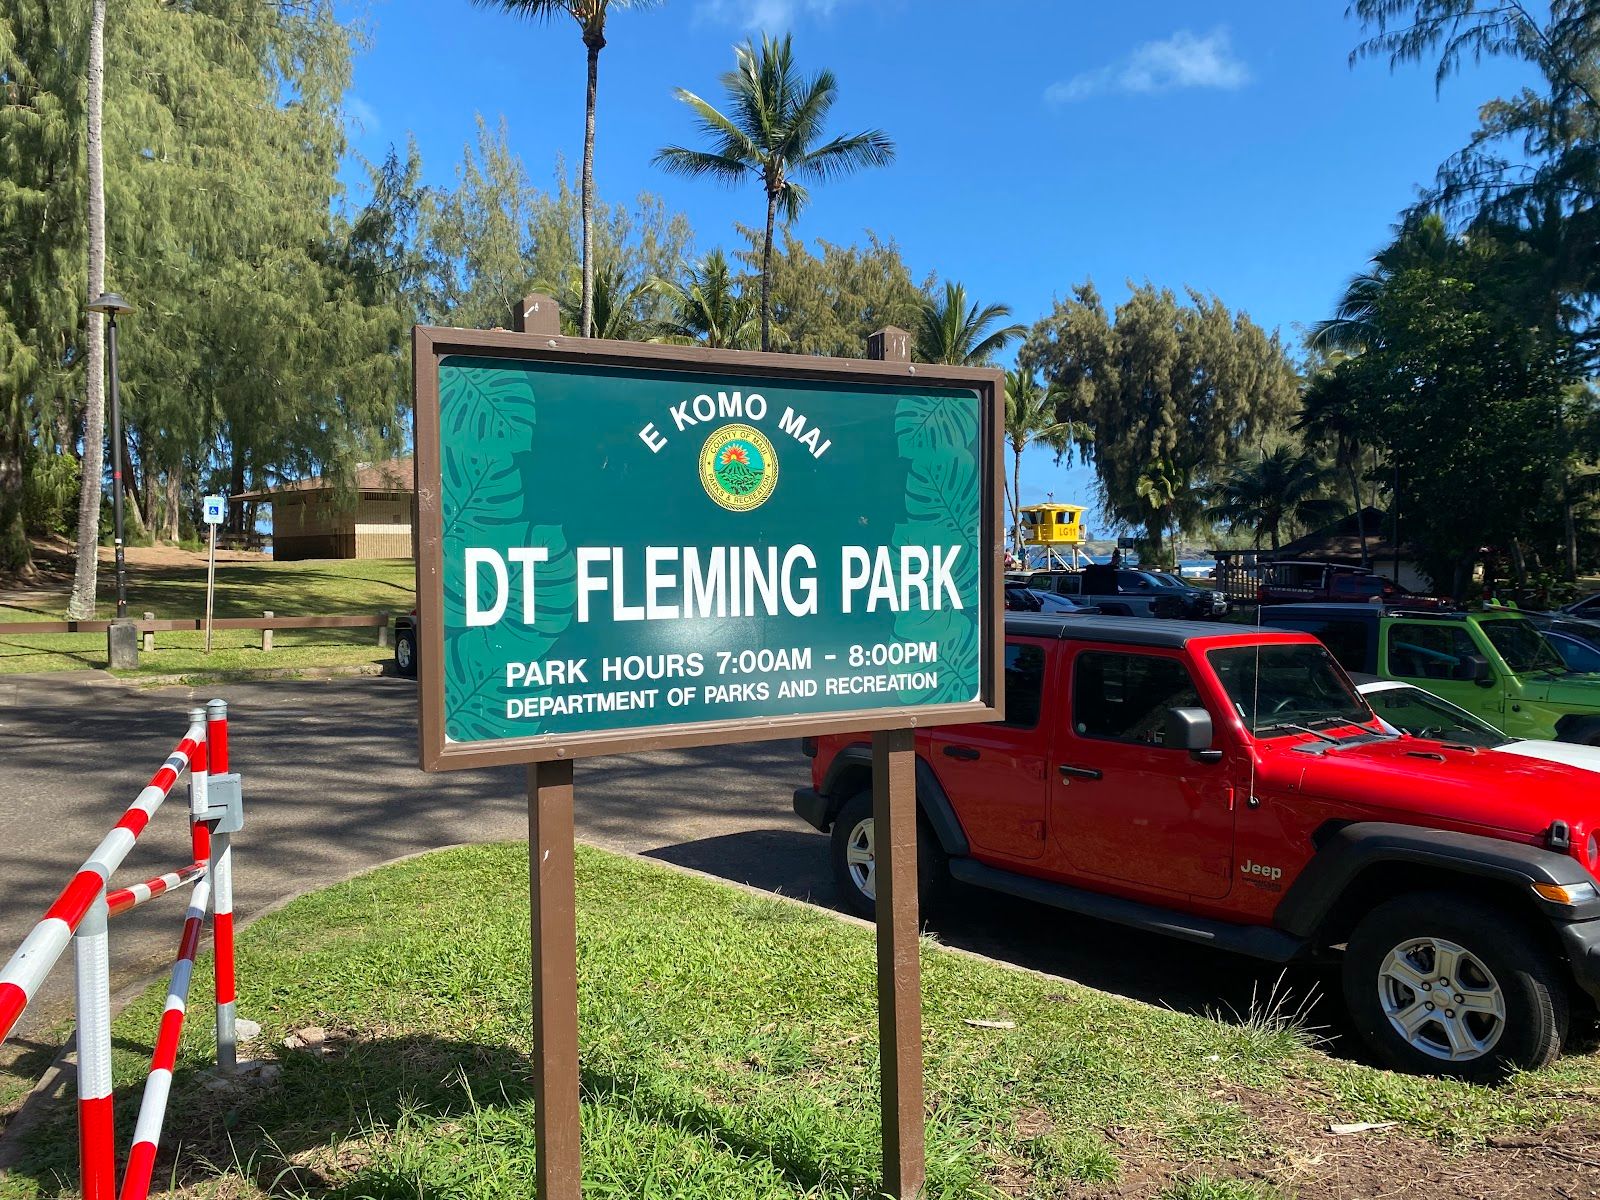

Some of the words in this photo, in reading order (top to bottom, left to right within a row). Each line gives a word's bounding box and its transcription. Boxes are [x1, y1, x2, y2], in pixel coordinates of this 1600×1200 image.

[638, 422, 668, 454] E
[669, 391, 767, 431] KOMO
[778, 406, 832, 459] MAI
[710, 431, 737, 454] COUNTY
[740, 431, 751, 439] OF
[752, 437, 768, 455] MAUI
[708, 473, 725, 497] PARKS
[734, 474, 771, 503] RECREATION
[1059, 527, 1076, 537] LG11
[464, 547, 549, 626] DT
[577, 544, 818, 623] FLEMING
[841, 544, 964, 614] PARK
[506, 658, 588, 688] PARK
[602, 652, 704, 682] HOURS
[716, 647, 812, 675] 7:00AM
[848, 641, 938, 667] 8:00PM
[506, 689, 659, 719] DEPARTMENT
[667, 687, 697, 707] OF
[704, 682, 770, 704] PARKS
[777, 679, 818, 699] AND
[825, 672, 938, 695] RECREATION
[1240, 859, 1281, 880] Jeep
